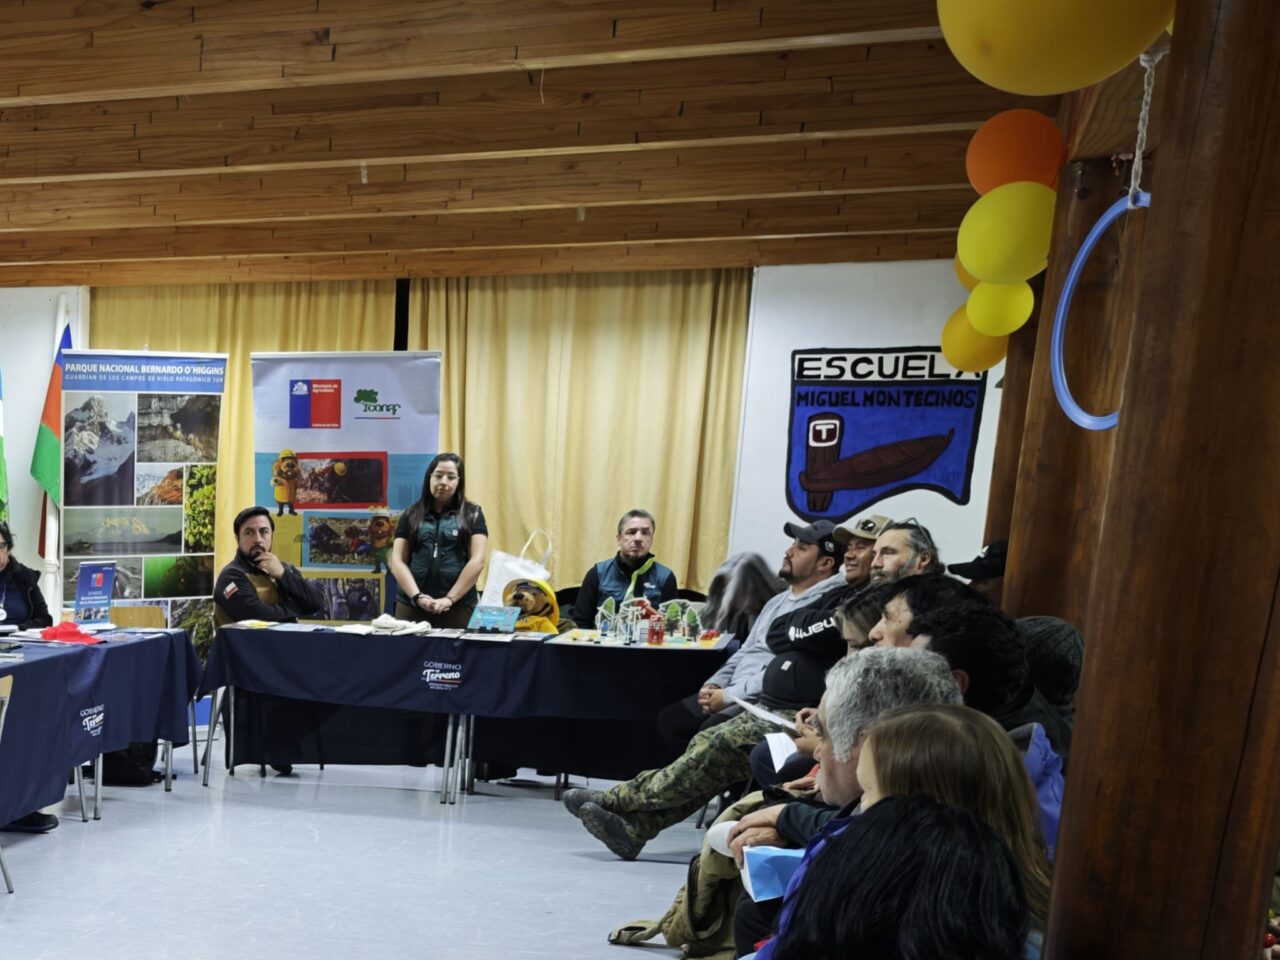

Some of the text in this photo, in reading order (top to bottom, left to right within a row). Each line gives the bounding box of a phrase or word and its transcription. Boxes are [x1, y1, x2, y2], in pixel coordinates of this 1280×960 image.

[65, 363, 98, 373] PARQUE
[99, 364, 140, 374] NACIONAL
[141, 365, 183, 374] BERNARDO
[796, 390, 861, 408] MIGUEL
[423, 661, 462, 670] GOBIERNO
[422, 669, 461, 682] Terreno
